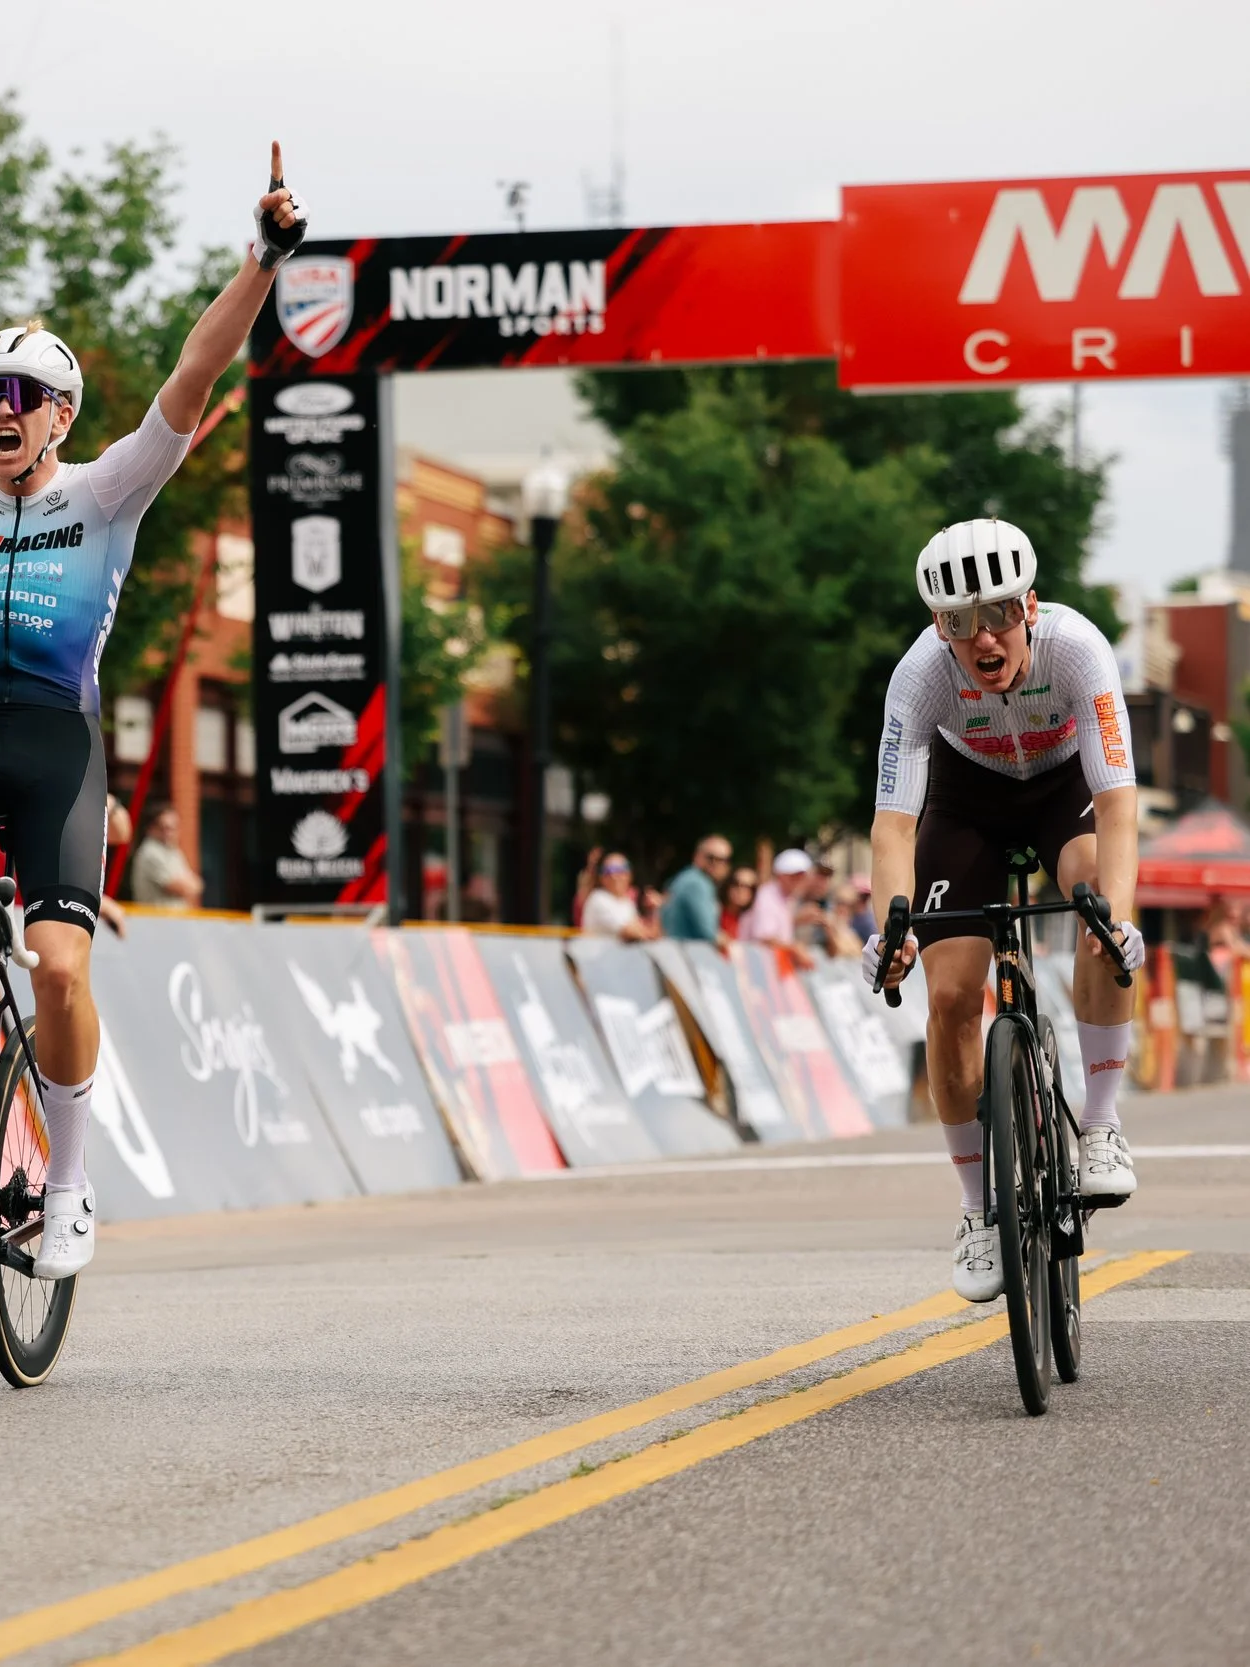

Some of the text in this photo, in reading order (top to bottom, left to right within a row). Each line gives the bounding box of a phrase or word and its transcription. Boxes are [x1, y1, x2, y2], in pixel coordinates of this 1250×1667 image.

[389, 260, 607, 321] NORMAN
[498, 314, 606, 337] SPORTS
[931, 570, 941, 594] POC
[1094, 692, 1127, 768] ATTAQUER
[880, 714, 904, 794] ATTAQUER
[923, 880, 950, 913] R
